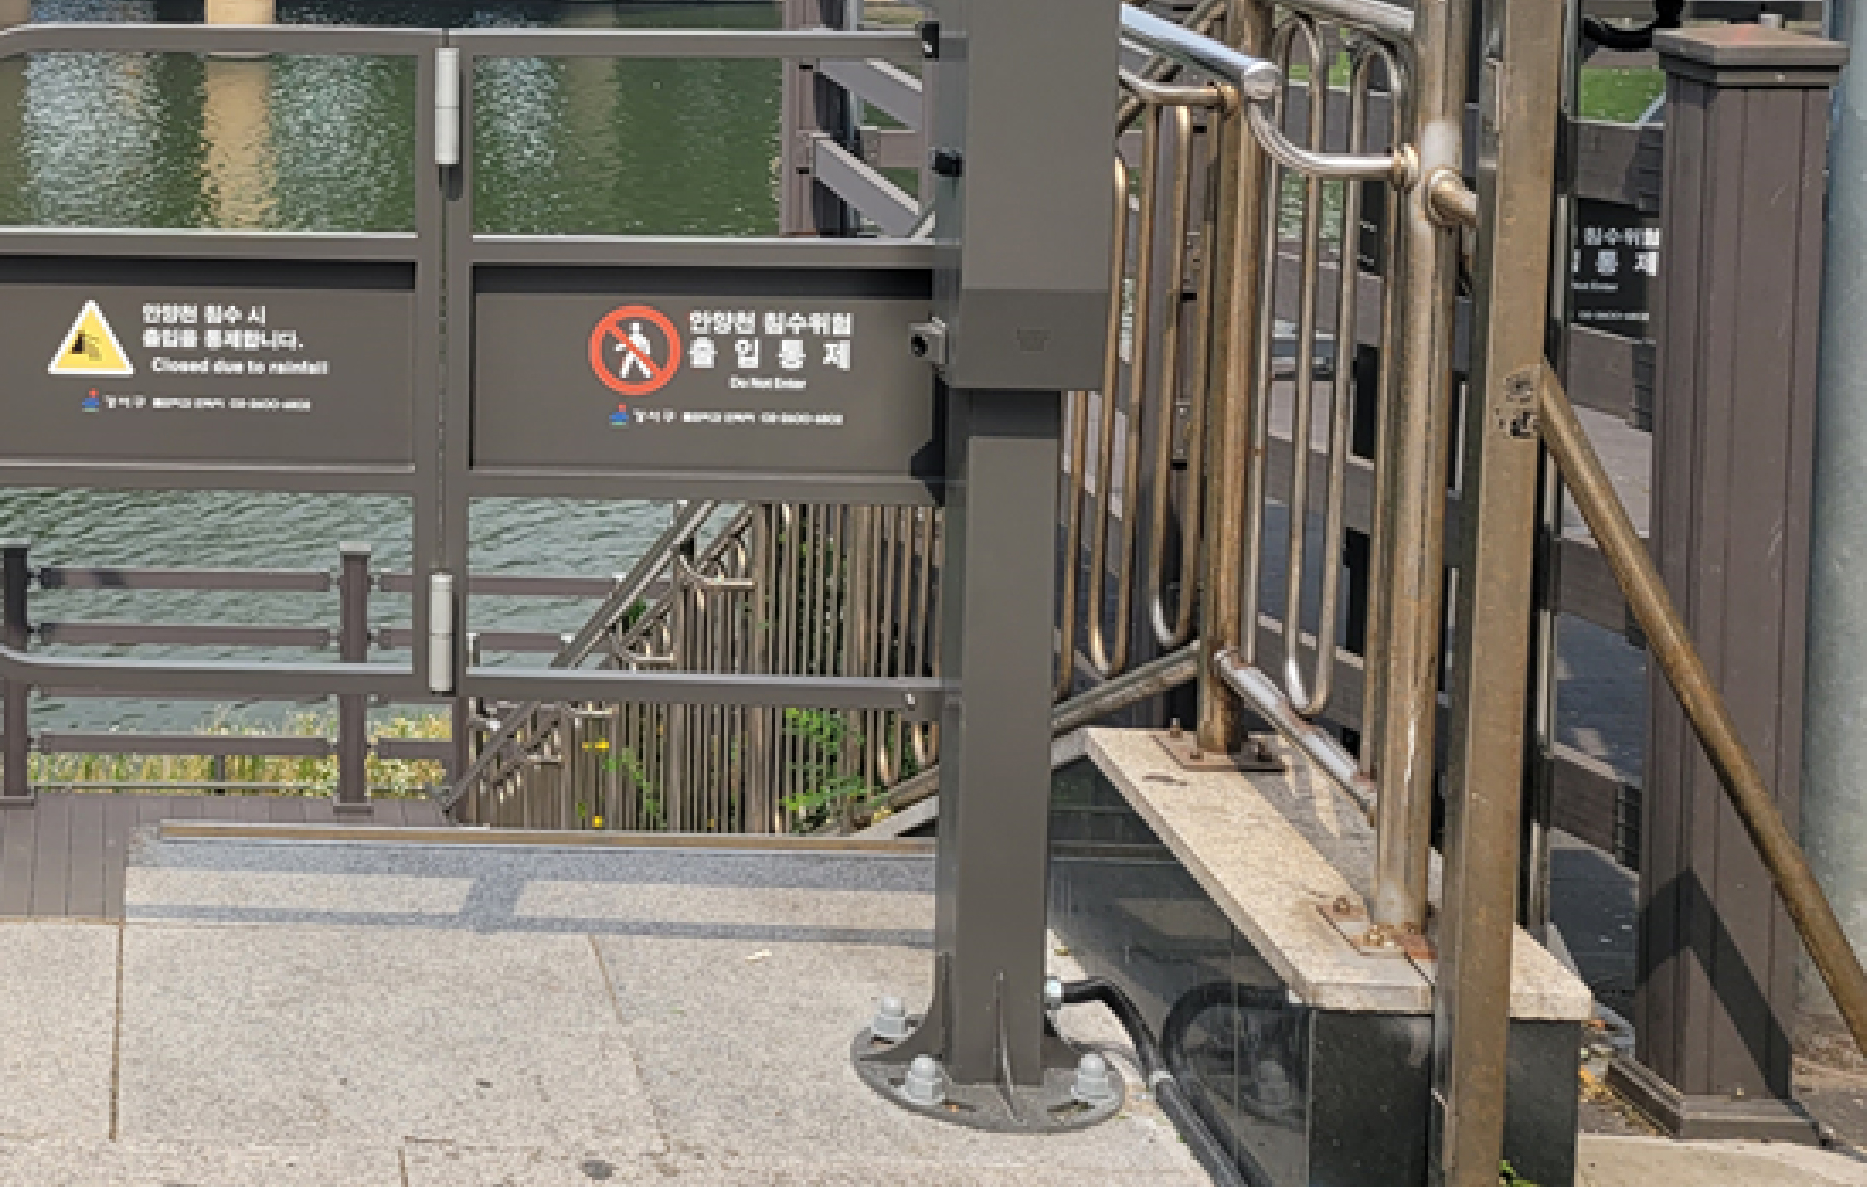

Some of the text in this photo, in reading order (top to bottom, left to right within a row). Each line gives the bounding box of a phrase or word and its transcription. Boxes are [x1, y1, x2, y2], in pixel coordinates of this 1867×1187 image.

[142, 304, 267, 326] 안양천 침수 시
[688, 309, 854, 337] 안양천 침수위험
[150, 357, 328, 377] Closed due to rainfall
[774, 376, 807, 391] Enter
